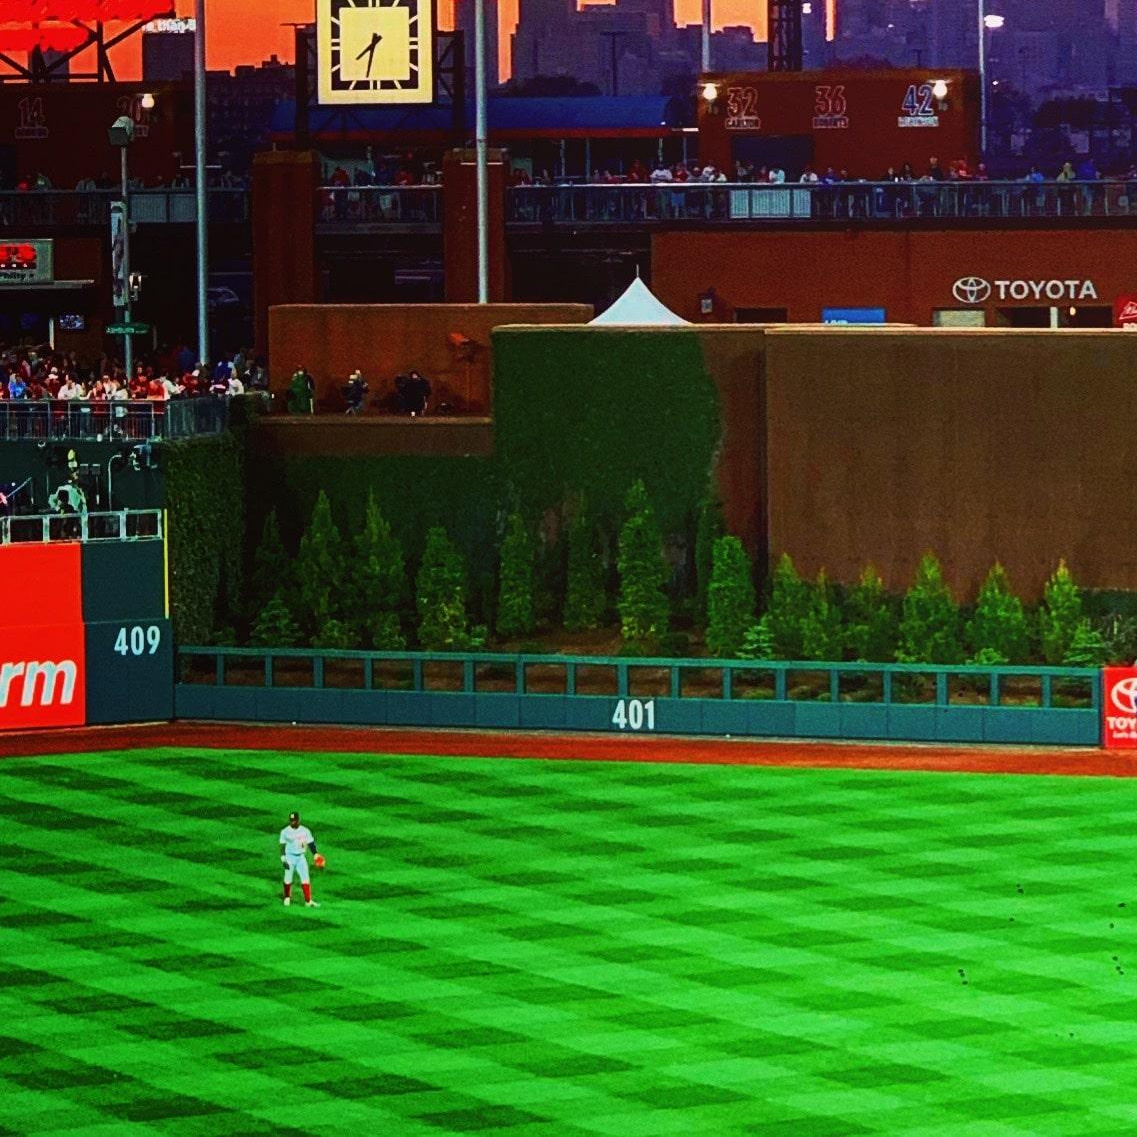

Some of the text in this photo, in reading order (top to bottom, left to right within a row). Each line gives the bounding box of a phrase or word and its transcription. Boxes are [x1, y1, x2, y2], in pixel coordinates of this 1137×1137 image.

[902, 84, 934, 115] 42
[995, 280, 1098, 299] TOYOTA
[114, 626, 161, 656] 409
[0, 660, 77, 708] rm
[612, 699, 655, 730] 401
